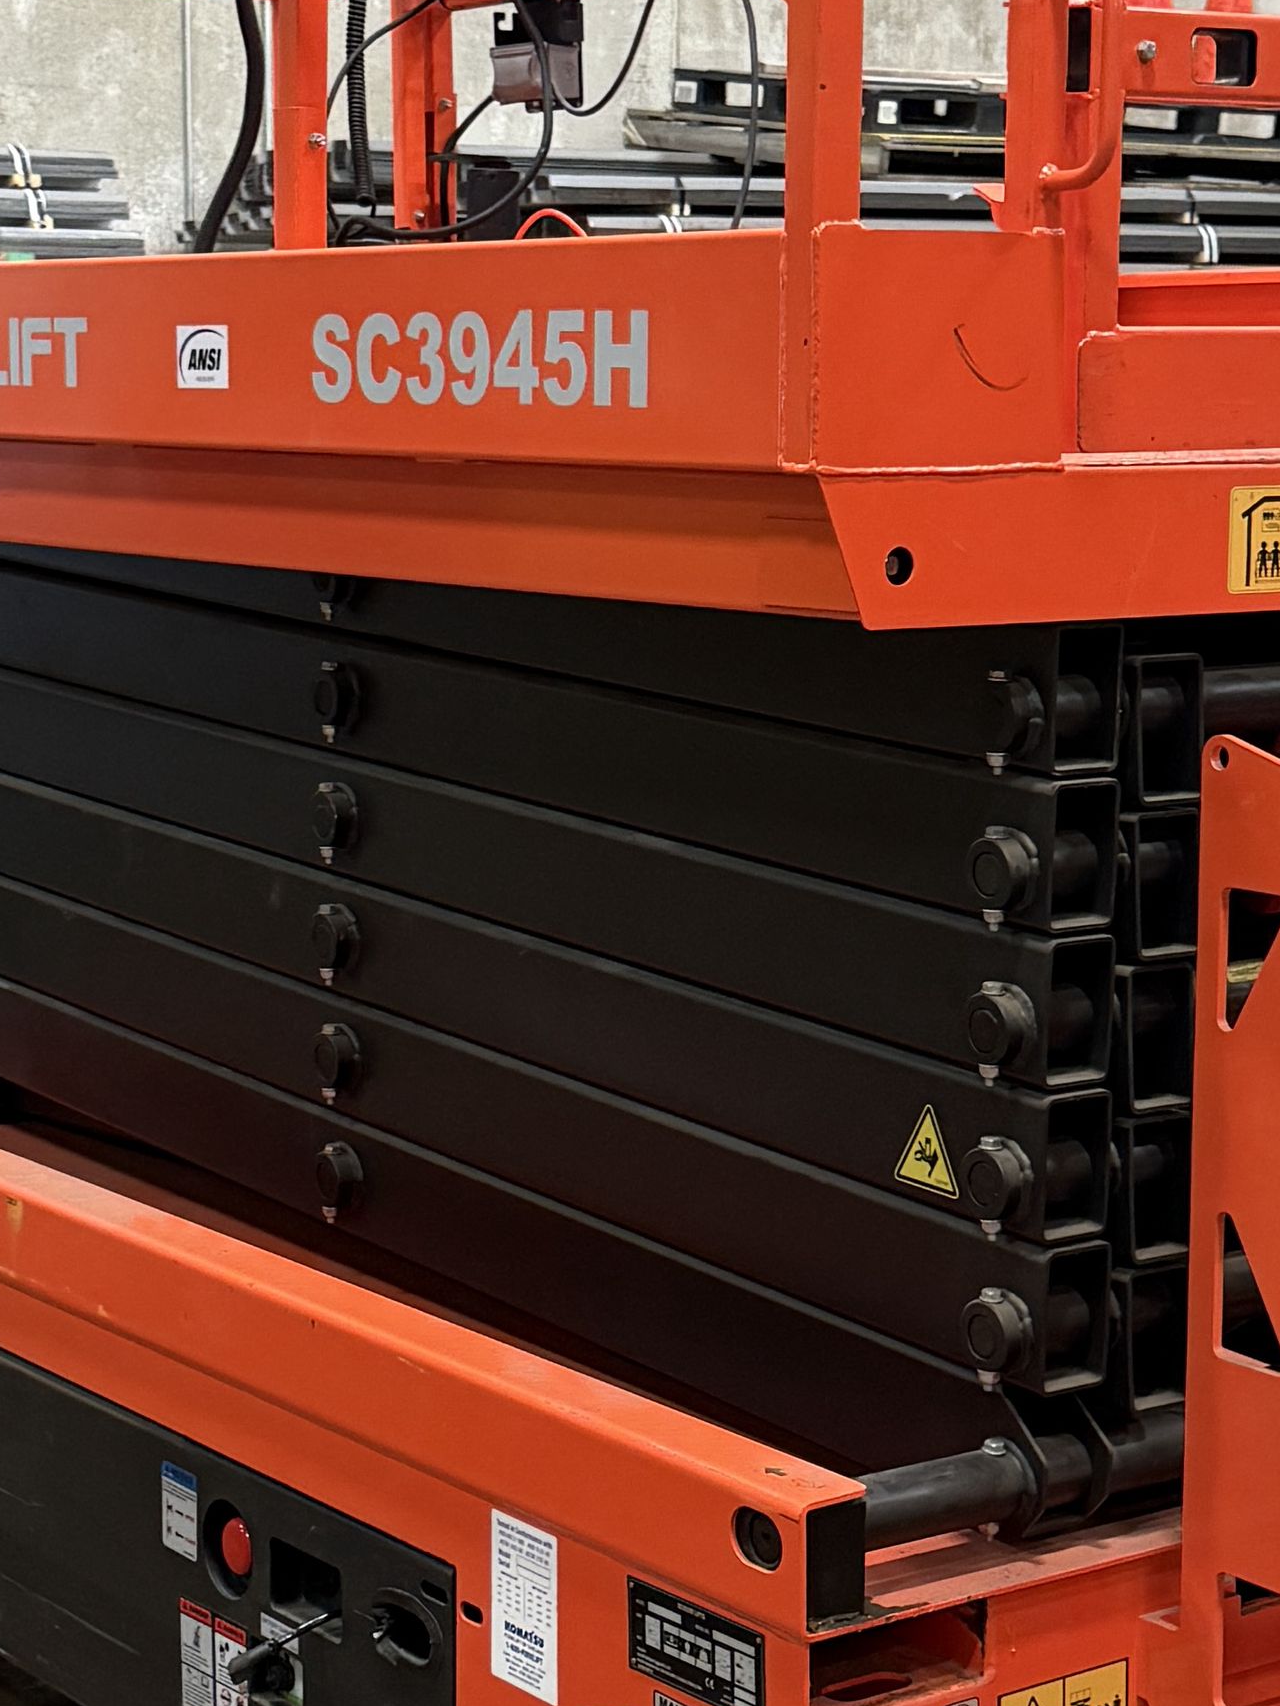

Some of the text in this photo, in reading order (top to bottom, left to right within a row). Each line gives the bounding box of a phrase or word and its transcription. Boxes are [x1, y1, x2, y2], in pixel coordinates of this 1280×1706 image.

[187, 348, 221, 371] ANSI
[311, 308, 650, 409] SC3945H
[503, 1620, 545, 1649] KOMATSU
